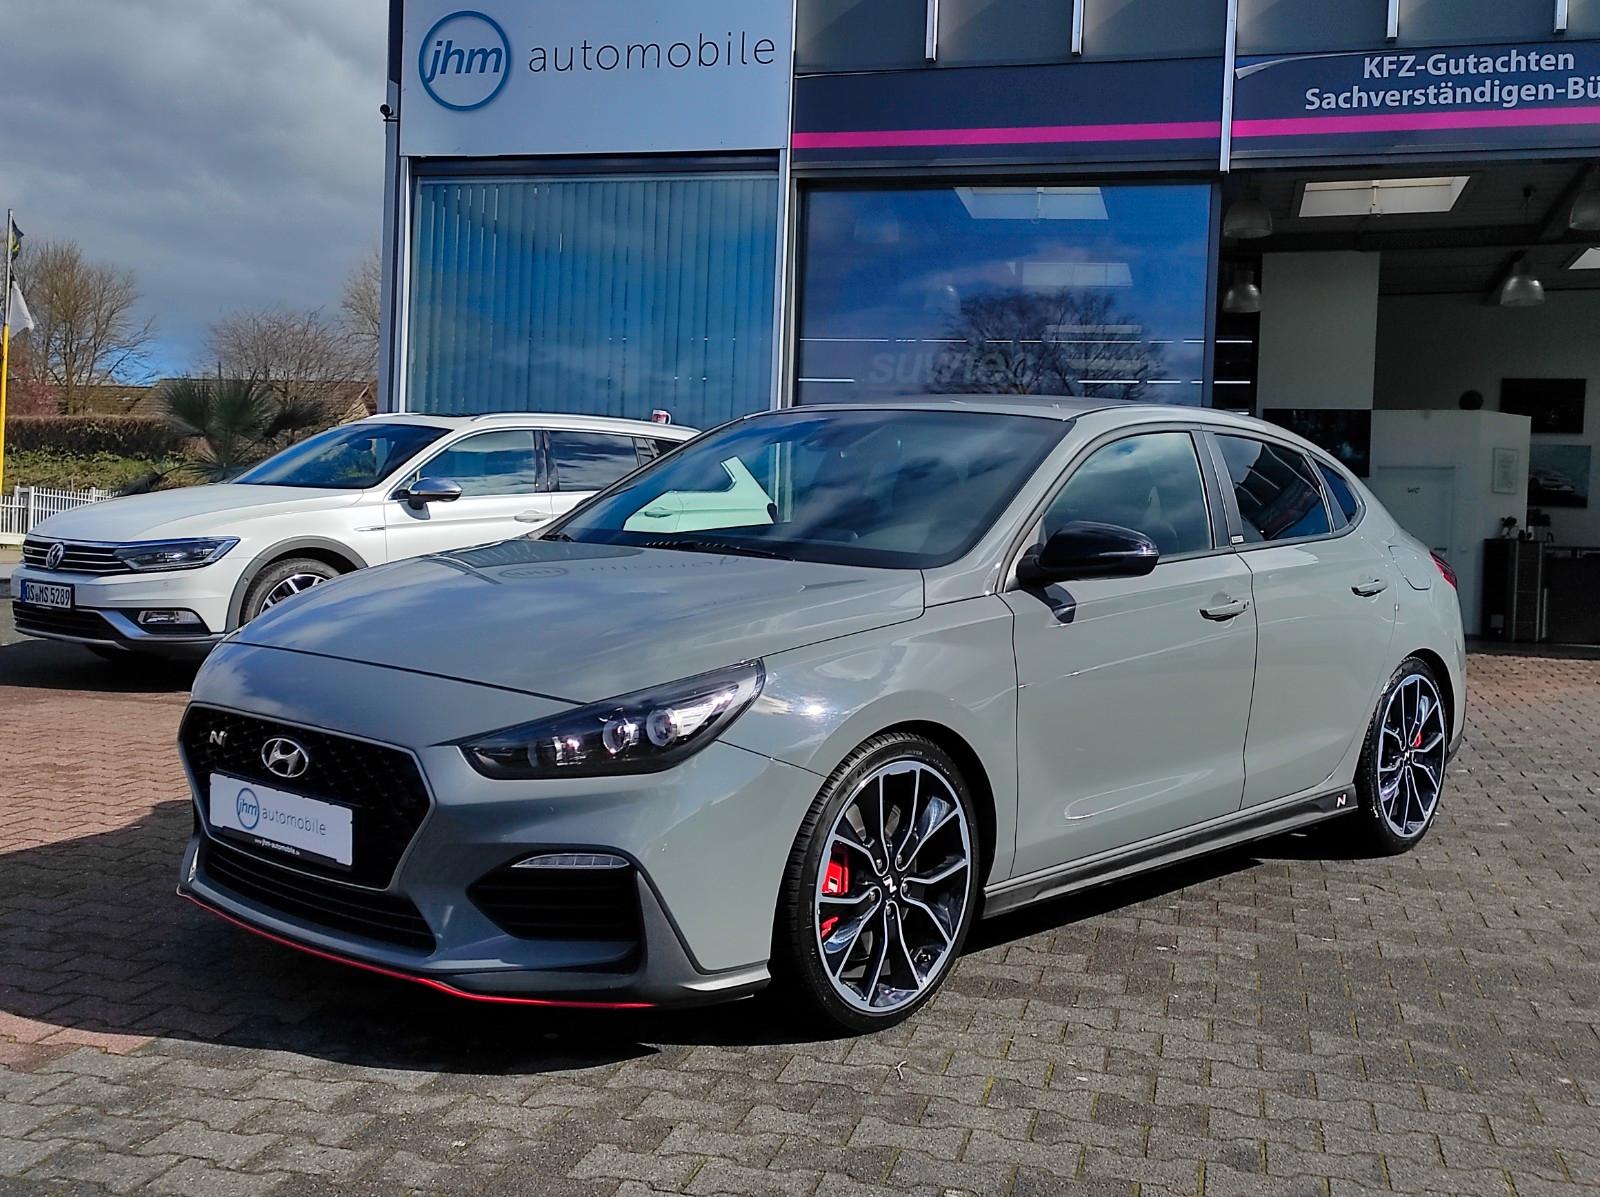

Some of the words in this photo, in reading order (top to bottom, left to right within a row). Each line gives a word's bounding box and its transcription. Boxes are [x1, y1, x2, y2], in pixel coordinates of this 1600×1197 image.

[425, 40, 503, 84] jhm
[528, 31, 775, 73] automobile
[1363, 50, 1575, 79] KFZ-Gutachten
[50, 587, 70, 606] 5289
[238, 797, 258, 818] jhm
[262, 807, 327, 836] automobile
